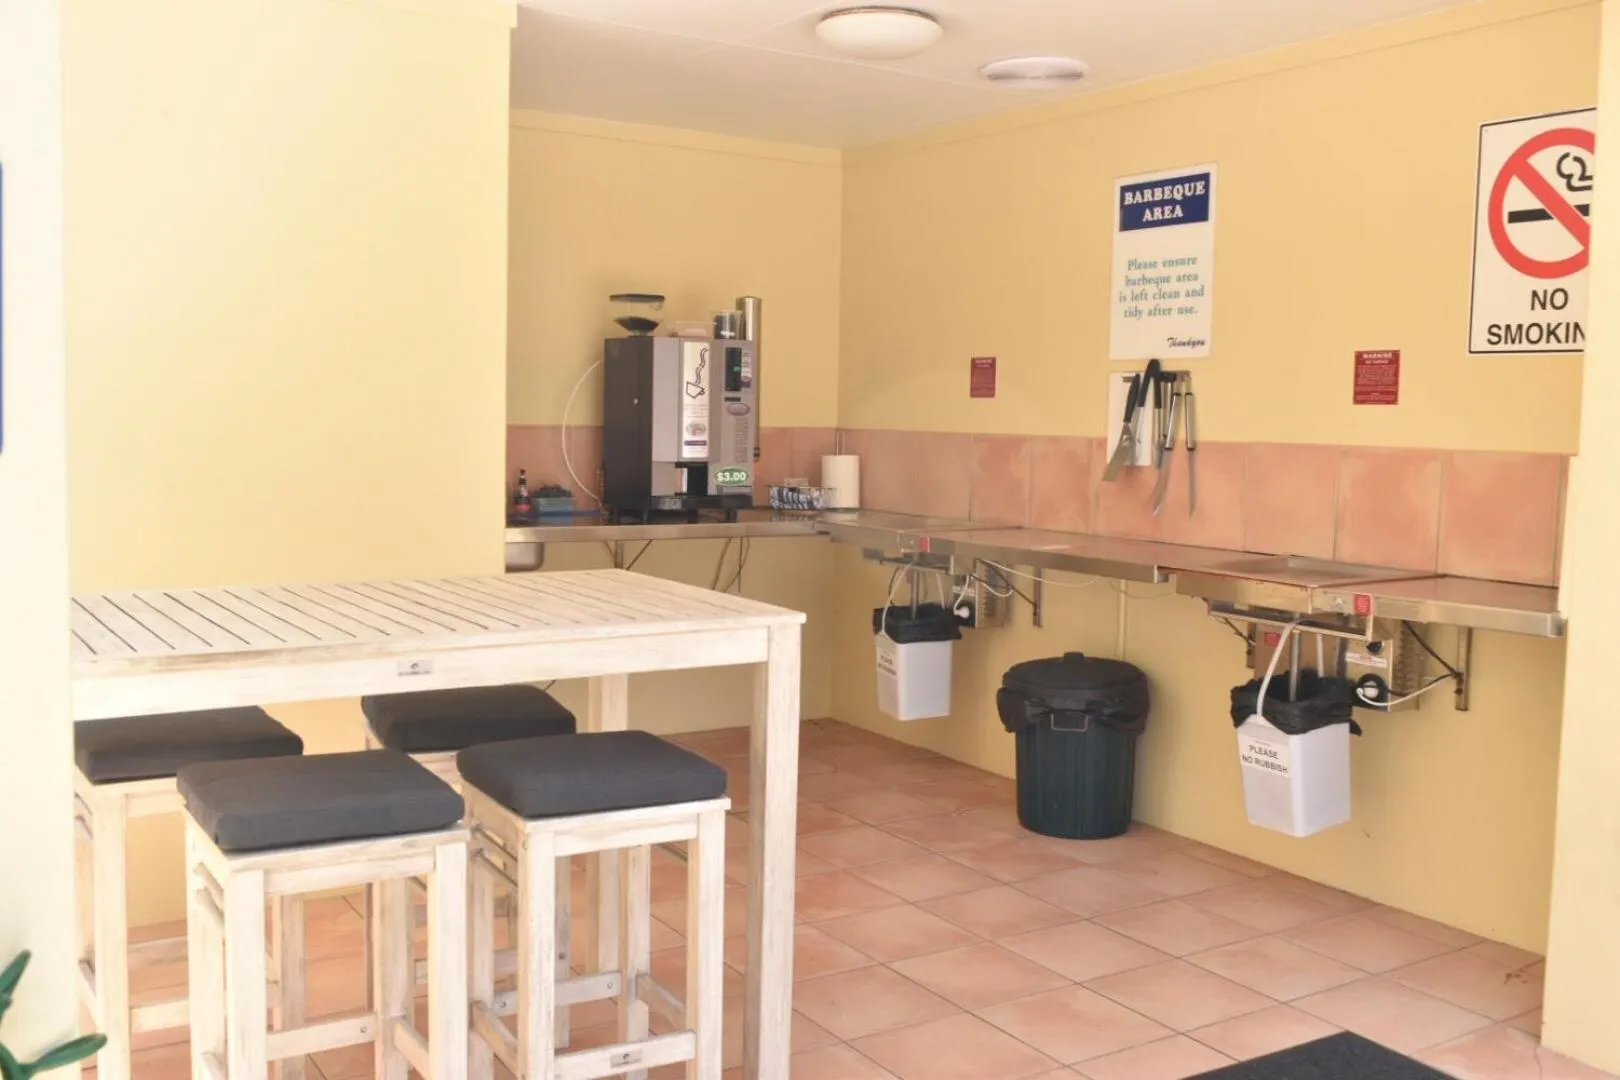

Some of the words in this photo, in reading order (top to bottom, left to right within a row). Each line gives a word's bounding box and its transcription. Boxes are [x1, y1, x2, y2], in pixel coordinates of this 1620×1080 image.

[1123, 180, 1206, 205] BARBEQUE
[1142, 204, 1184, 222] AREA
[1127, 257, 1158, 271] Please
[1162, 256, 1198, 268] ensure
[1125, 273, 1172, 287] barbeque
[1175, 272, 1199, 282] area
[1119, 291, 1127, 303] is
[1130, 288, 1149, 302] left
[1152, 288, 1181, 300] clean
[1184, 284, 1205, 298] and
[1530, 287, 1569, 311] NO
[1123, 305, 1144, 320] tidy
[1146, 304, 1173, 317] after
[1177, 305, 1200, 316] use.
[1486, 322, 1586, 345] SMOKIN
[1166, 336, 1206, 349] Thankyou
[716, 471, 747, 483] $3.00
[1248, 744, 1279, 760] PLEASE
[1241, 753, 1254, 764] NO
[1254, 757, 1289, 774] RUBBISH
